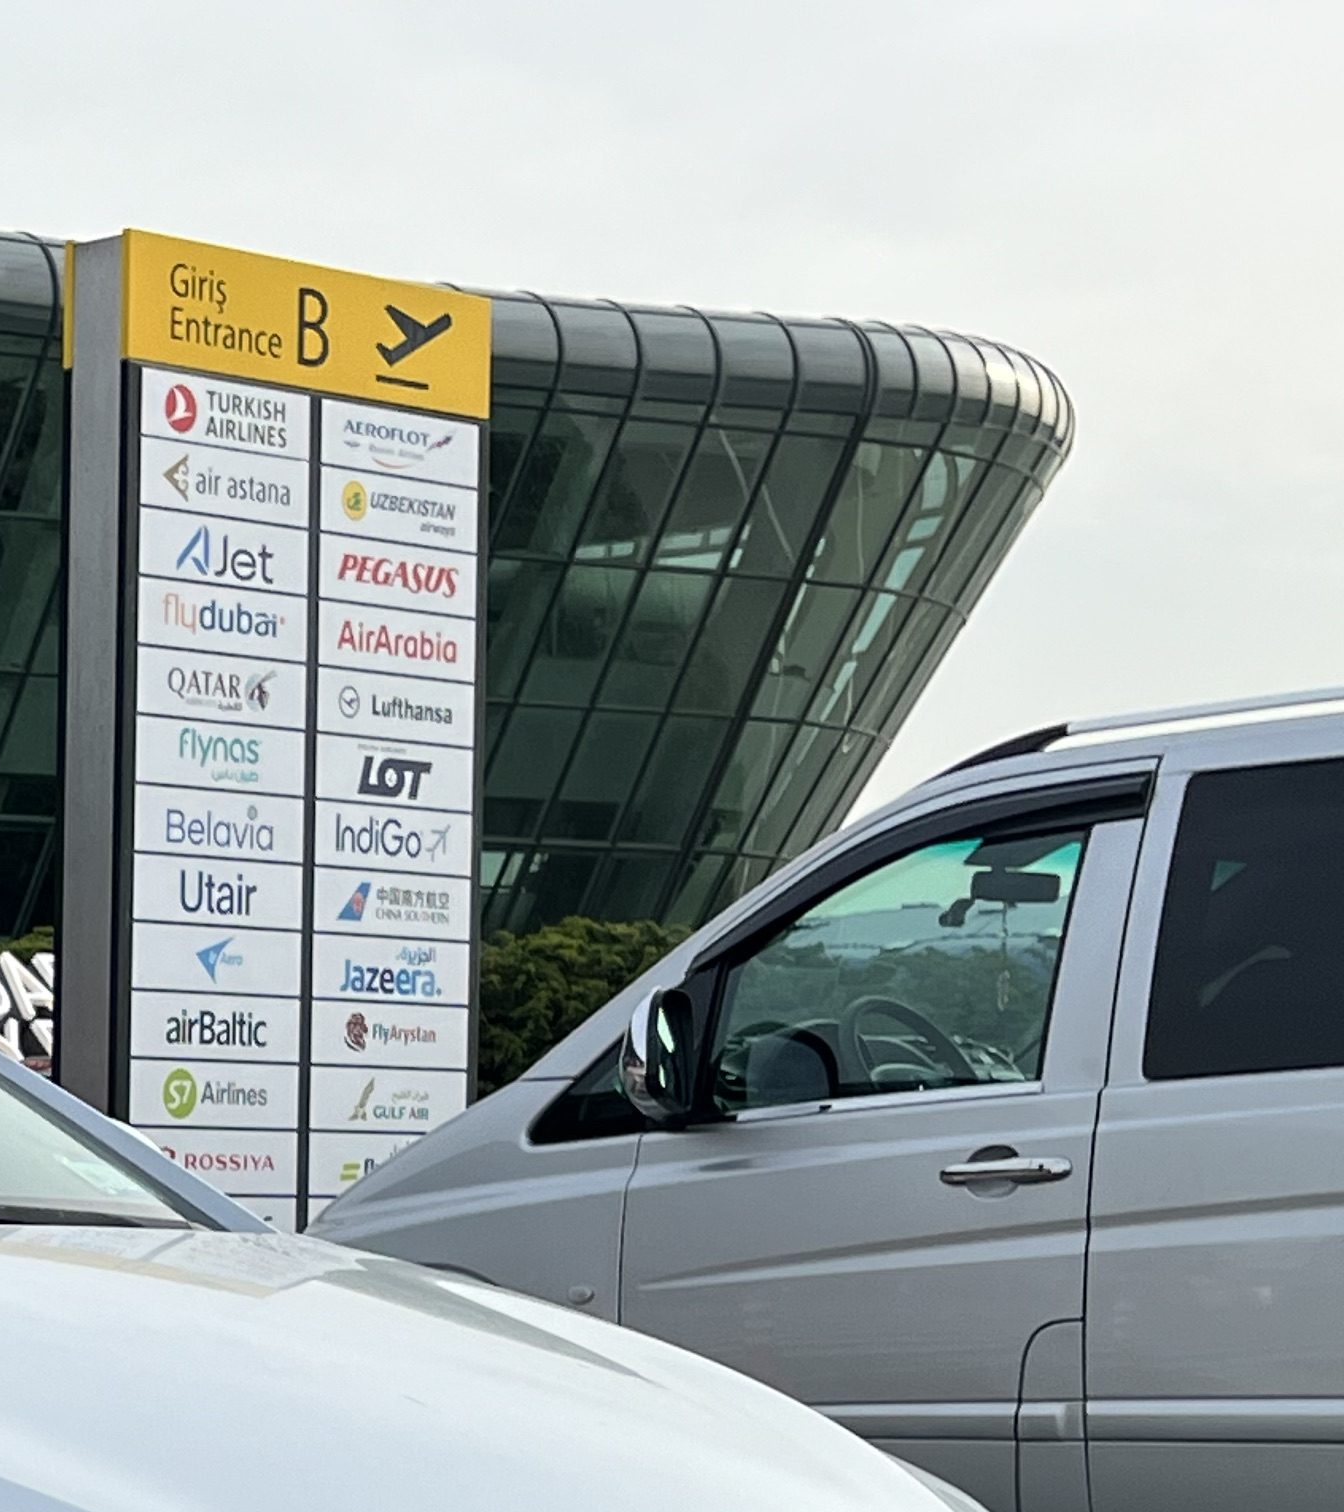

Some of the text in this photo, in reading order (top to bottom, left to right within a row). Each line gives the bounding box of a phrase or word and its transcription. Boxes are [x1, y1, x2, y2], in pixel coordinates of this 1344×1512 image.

[170, 263, 227, 313] Giriş
[170, 307, 282, 358] Entrance
[297, 286, 330, 368] B
[206, 390, 286, 422] TURKISH
[205, 417, 287, 449] AIRLINES
[344, 419, 431, 447] AEROFLOT
[195, 467, 291, 507] air astana
[370, 491, 455, 520] UZBEKISTAN
[420, 521, 455, 538] airways
[337, 553, 459, 598] PEGASUS
[162, 592, 278, 638] flydubai
[337, 620, 457, 664] AirArabia
[168, 667, 241, 699] QATAR
[372, 694, 453, 724] Lufthansa
[179, 727, 260, 768] flynas
[358, 756, 433, 800] LOT
[166, 805, 274, 851] Belavia
[335, 813, 422, 859] IndiGo
[180, 869, 257, 916] Utair
[165, 1009, 267, 1047] airBaltic
[372, 1023, 437, 1046] FlyArystan
[167, 1079, 268, 1110] S7 Airlines
[373, 1105, 406, 1120] GULF
[184, 1153, 275, 1171] ROSSIYA
